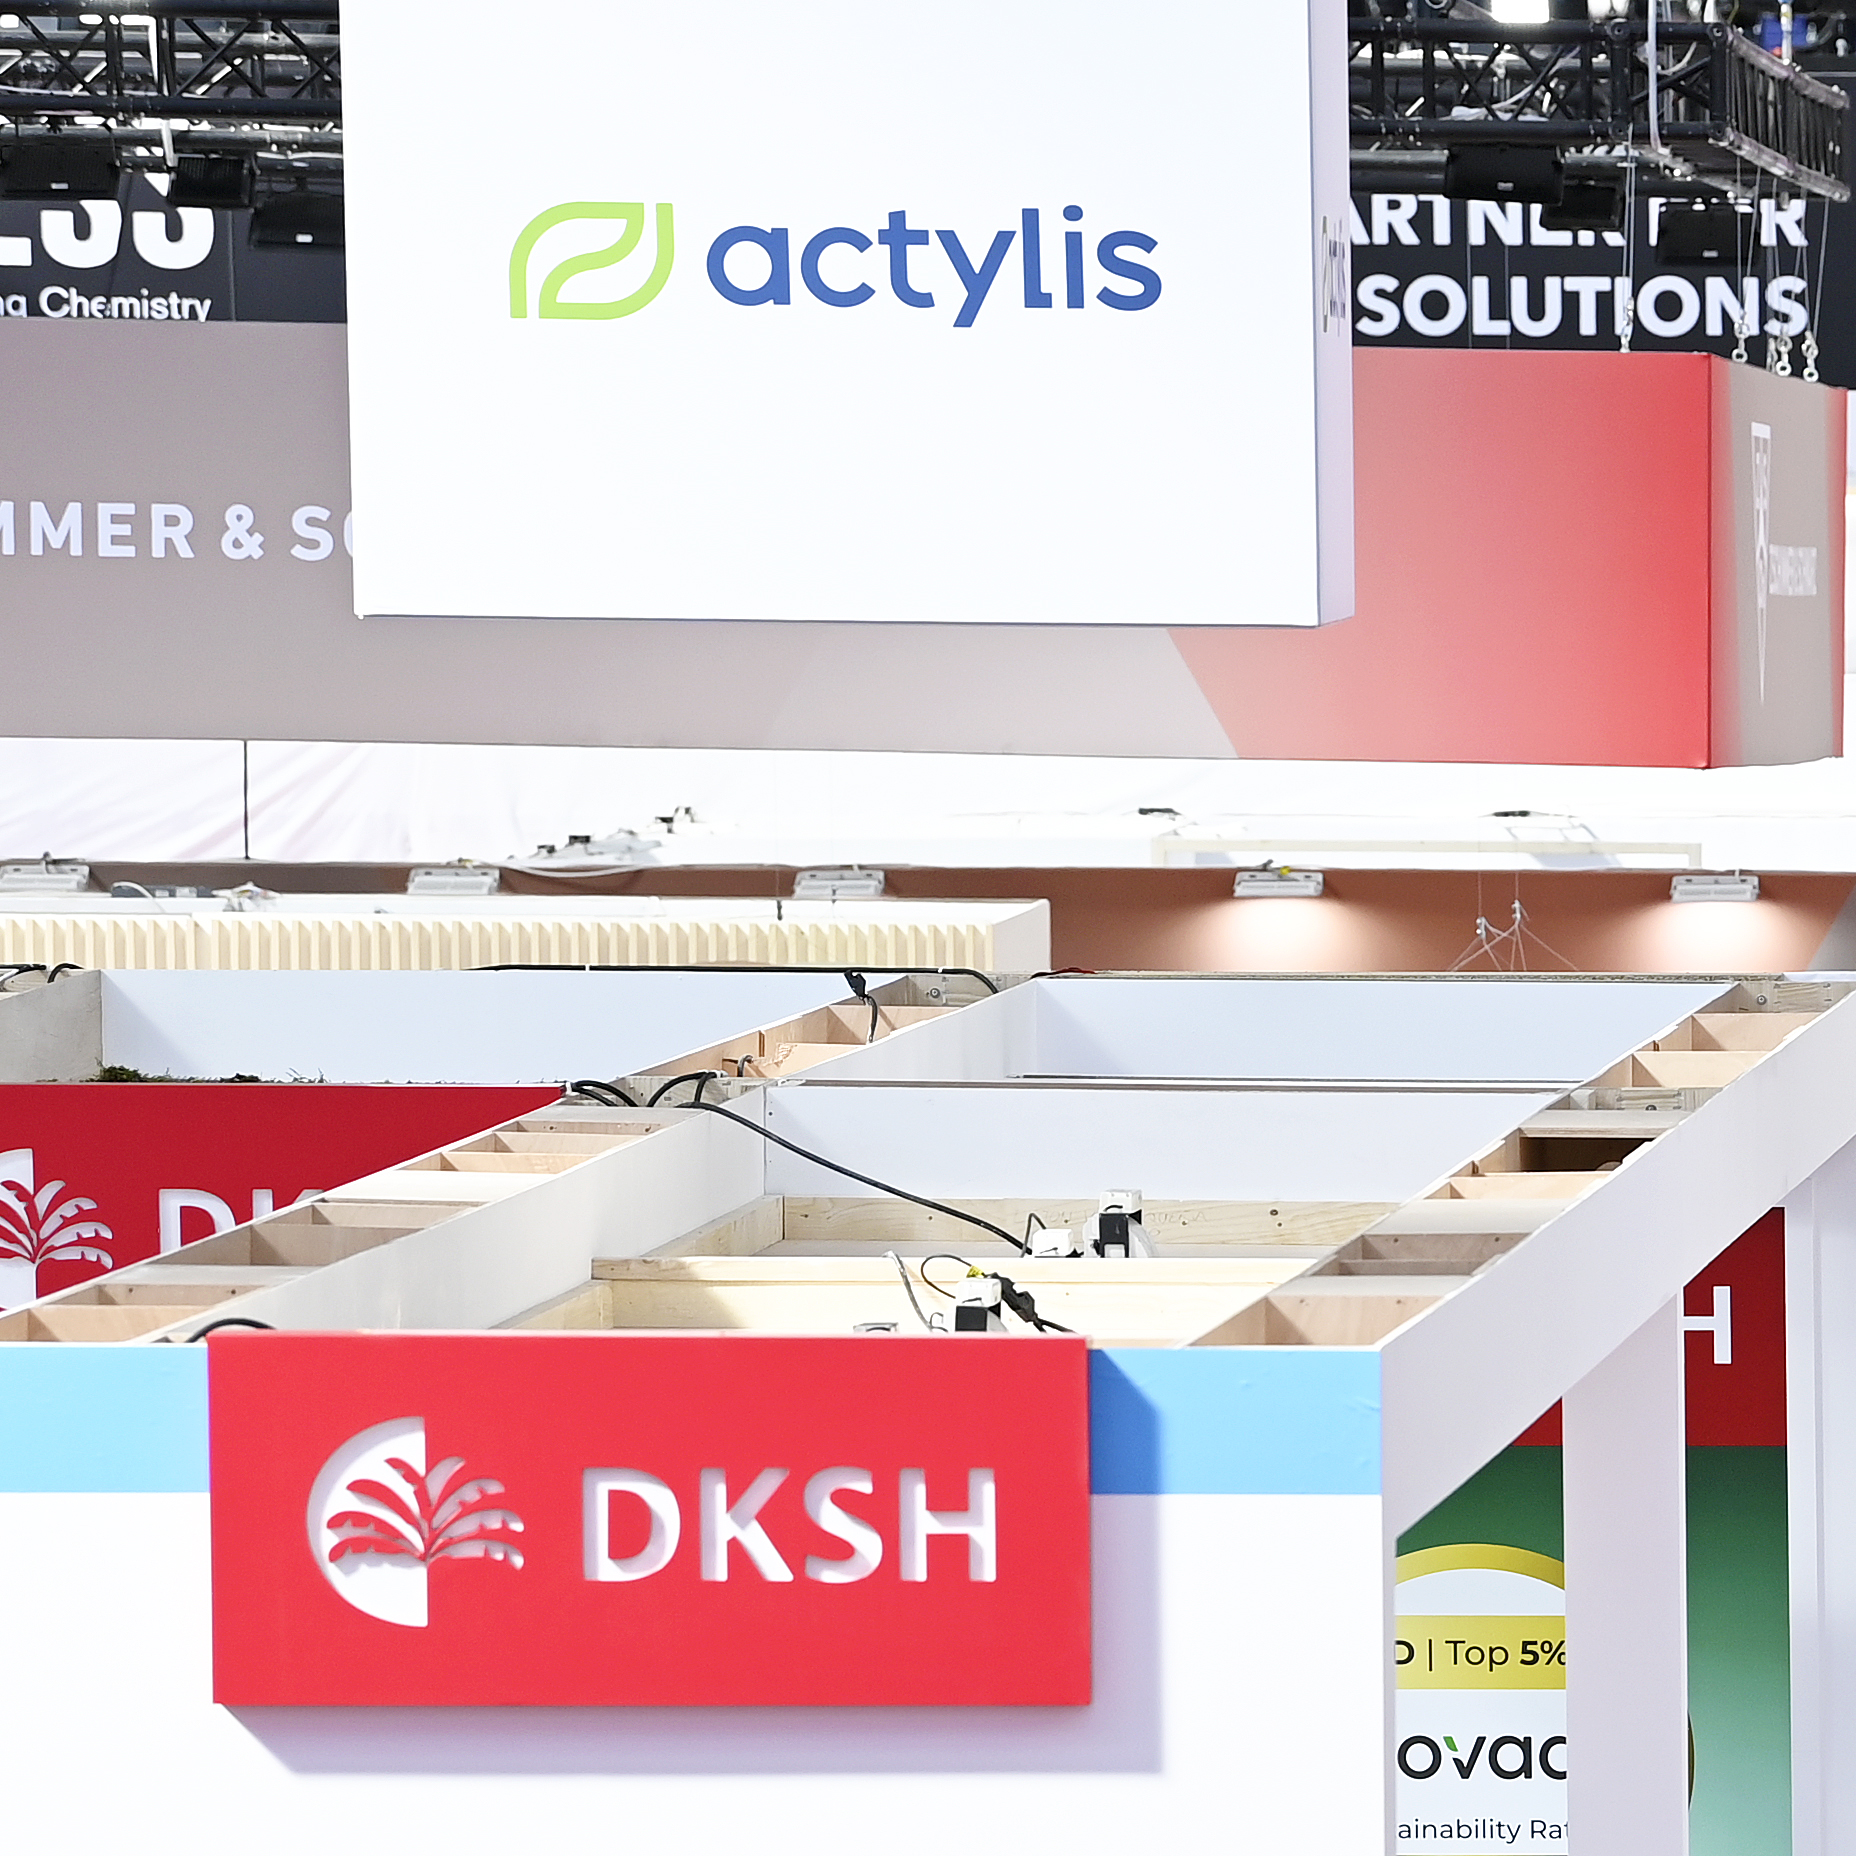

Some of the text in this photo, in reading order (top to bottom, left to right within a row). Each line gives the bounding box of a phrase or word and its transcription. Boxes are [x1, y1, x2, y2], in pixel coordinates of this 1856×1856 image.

[707, 205, 1162, 327] actylis
[1355, 273, 1811, 338] SOLUTIONS
[583, 1467, 996, 1583] DKSH
[1445, 1641, 1508, 1672] Top
